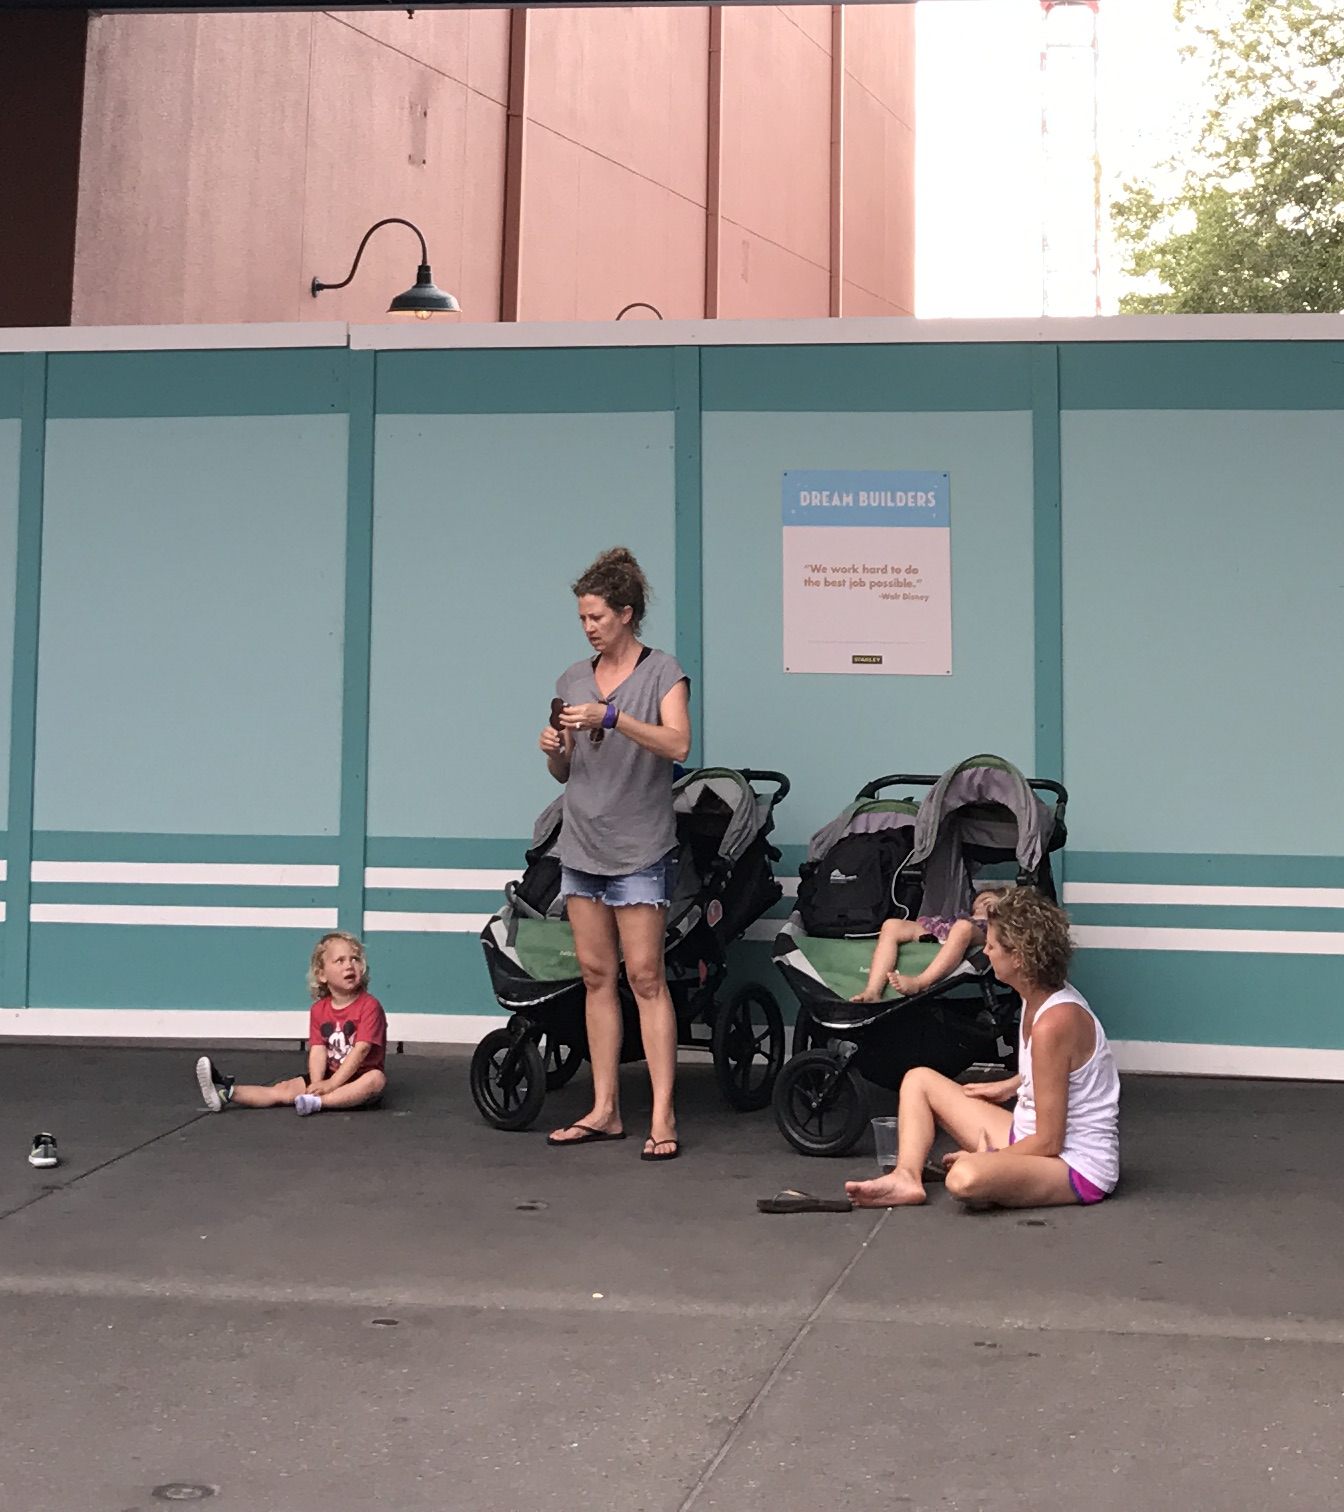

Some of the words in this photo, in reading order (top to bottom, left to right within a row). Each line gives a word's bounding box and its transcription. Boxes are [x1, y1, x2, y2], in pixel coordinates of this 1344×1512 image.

[800, 491, 853, 506] DREAM
[858, 491, 935, 507] BUILDERS
[830, 564, 859, 574] work
[862, 564, 887, 575] hard
[890, 566, 901, 574] to
[904, 565, 919, 575] do
[804, 577, 820, 587] the
[824, 577, 846, 587] best
[849, 577, 866, 589] job
[902, 593, 929, 602] Disney
